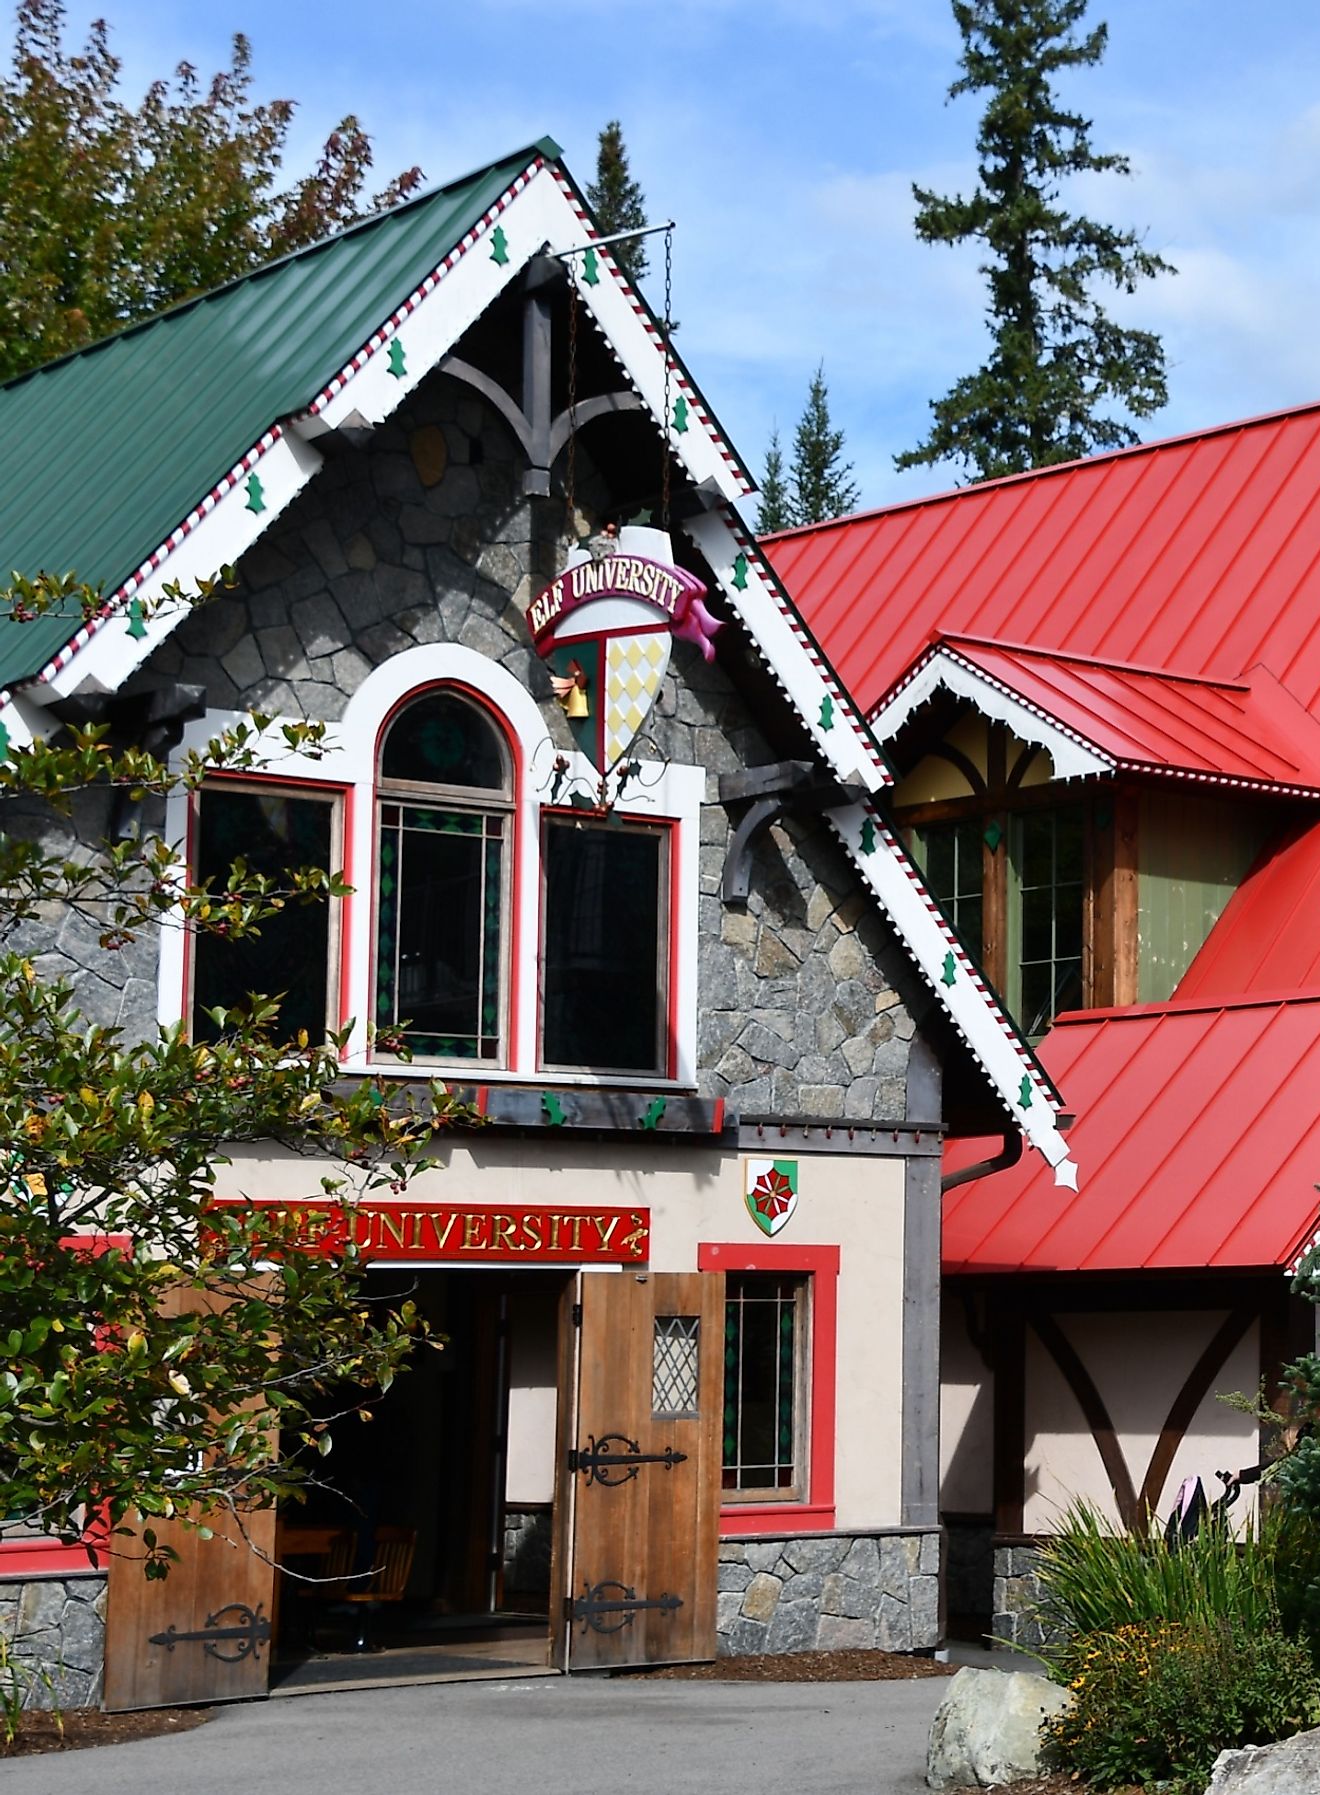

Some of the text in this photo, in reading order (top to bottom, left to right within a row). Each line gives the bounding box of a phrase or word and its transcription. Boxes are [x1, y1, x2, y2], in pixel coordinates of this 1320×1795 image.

[530, 558, 684, 635] ELF UNIVERSITY
[348, 1211, 619, 1251] UNIVERSITY
